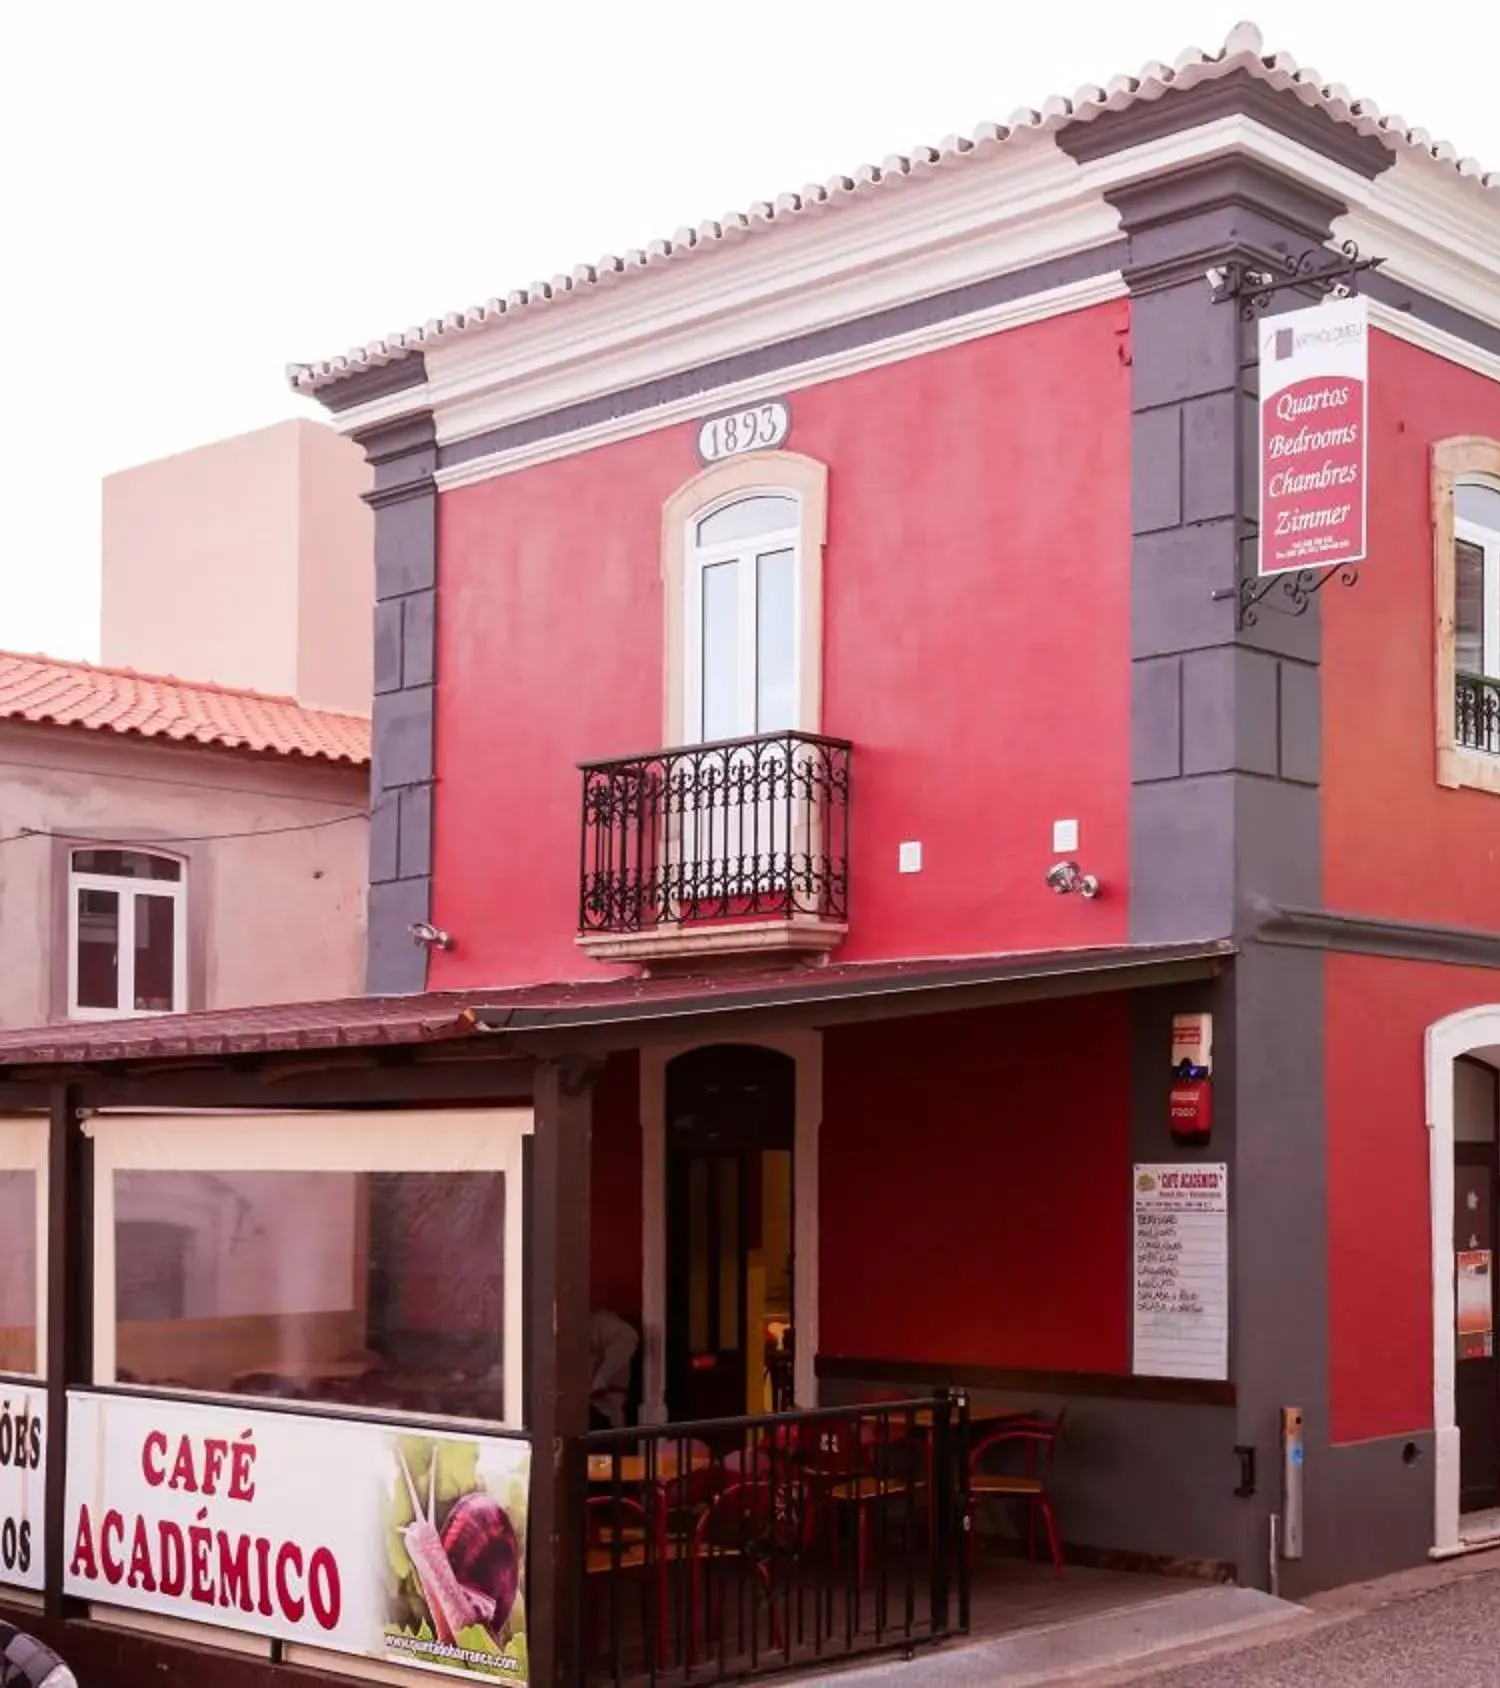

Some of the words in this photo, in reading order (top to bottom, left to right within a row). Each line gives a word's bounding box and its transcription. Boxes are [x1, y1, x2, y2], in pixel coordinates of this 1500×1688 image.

[1276, 386, 1350, 421] Quartos
[711, 406, 777, 457] 1893
[1268, 423, 1358, 459] Bedrooms
[1268, 459, 1358, 497] Chambres
[1273, 504, 1351, 537] Zimmer
[142, 1428, 257, 1503] CAFÉ
[70, 1503, 341, 1631] ACADÉMICO
